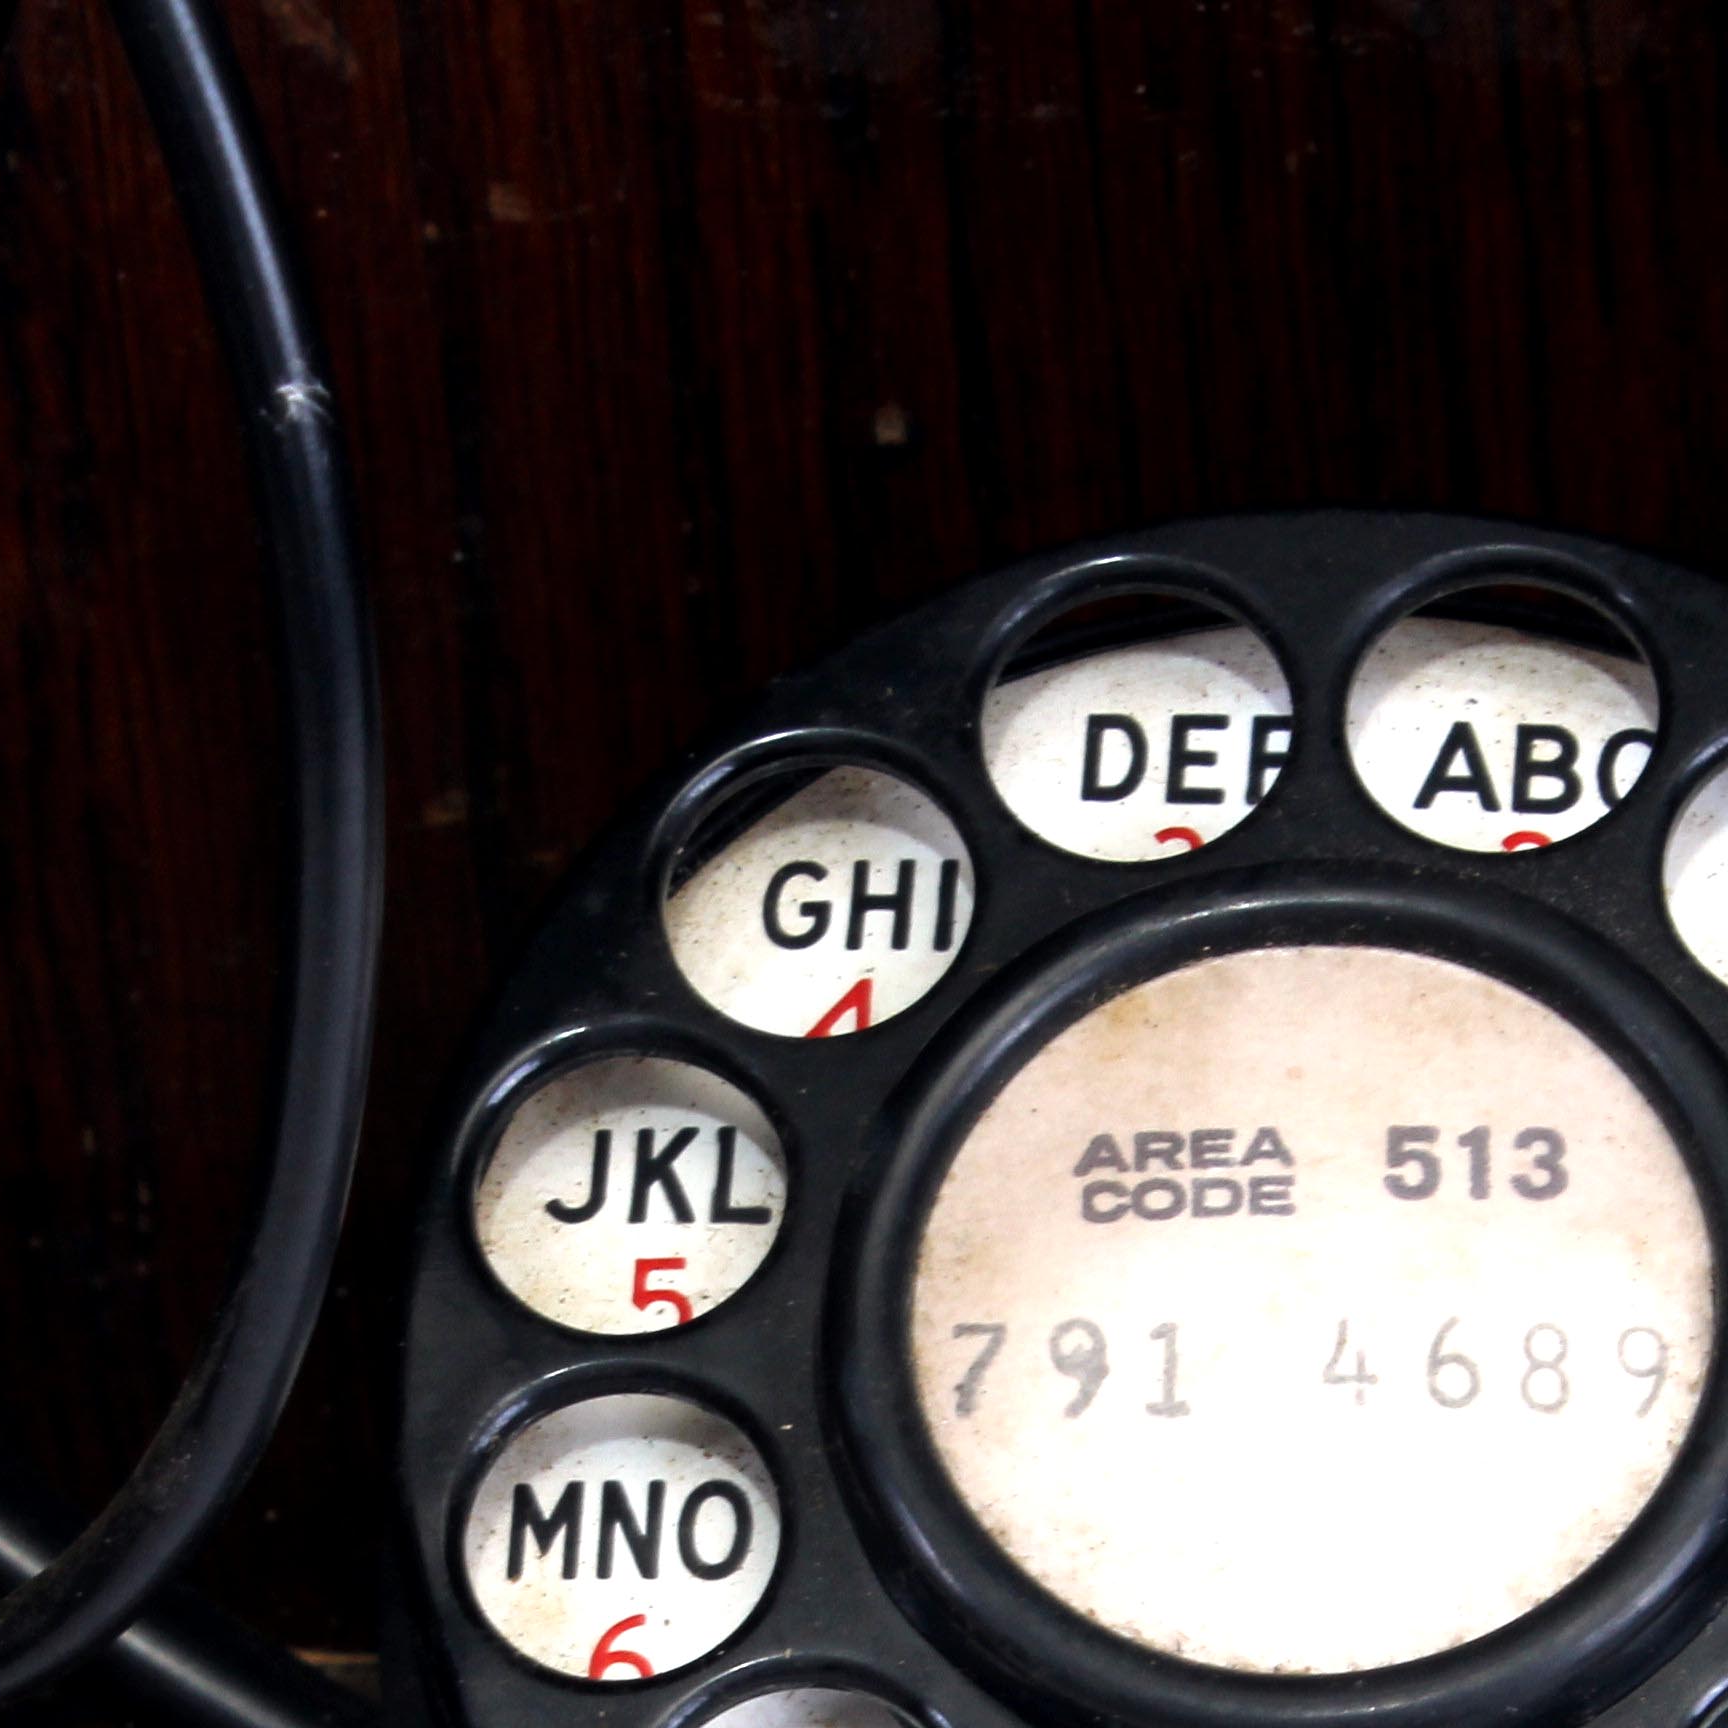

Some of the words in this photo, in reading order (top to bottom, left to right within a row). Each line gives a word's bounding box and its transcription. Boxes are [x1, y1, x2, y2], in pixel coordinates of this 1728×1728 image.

[762, 858, 959, 951] GHI
[546, 1124, 772, 1225] JKL
[1074, 1126, 1296, 1178] AREA
[1384, 1126, 1569, 1201] 513
[1081, 1176, 1297, 1223] CODE
[630, 1256, 692, 1326] 5
[952, 1318, 1191, 1419] 791
[1323, 1318, 1670, 1418] 4689
[506, 1478, 752, 1582] MNO
[589, 1614, 653, 1678] 6
